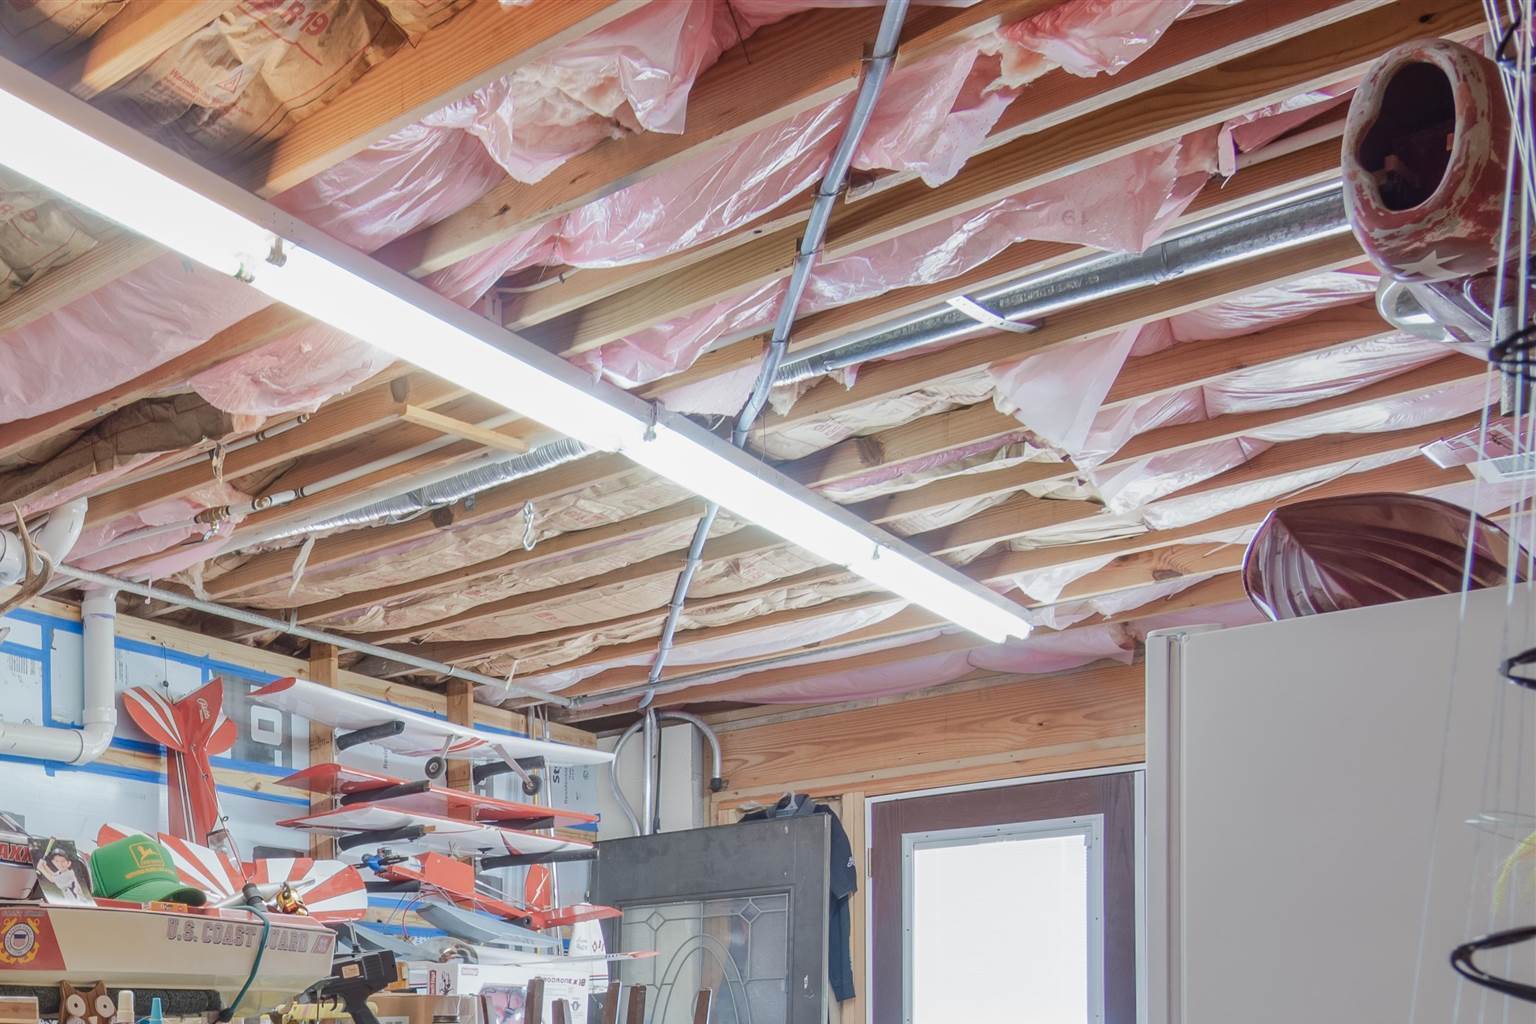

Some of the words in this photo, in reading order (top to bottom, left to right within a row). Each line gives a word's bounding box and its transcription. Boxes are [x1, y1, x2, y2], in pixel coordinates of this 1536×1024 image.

[279, 0, 330, 37] R-19
[166, 917, 198, 943] U.S.
[201, 921, 258, 949] COAST
[261, 927, 310, 953] UARD
